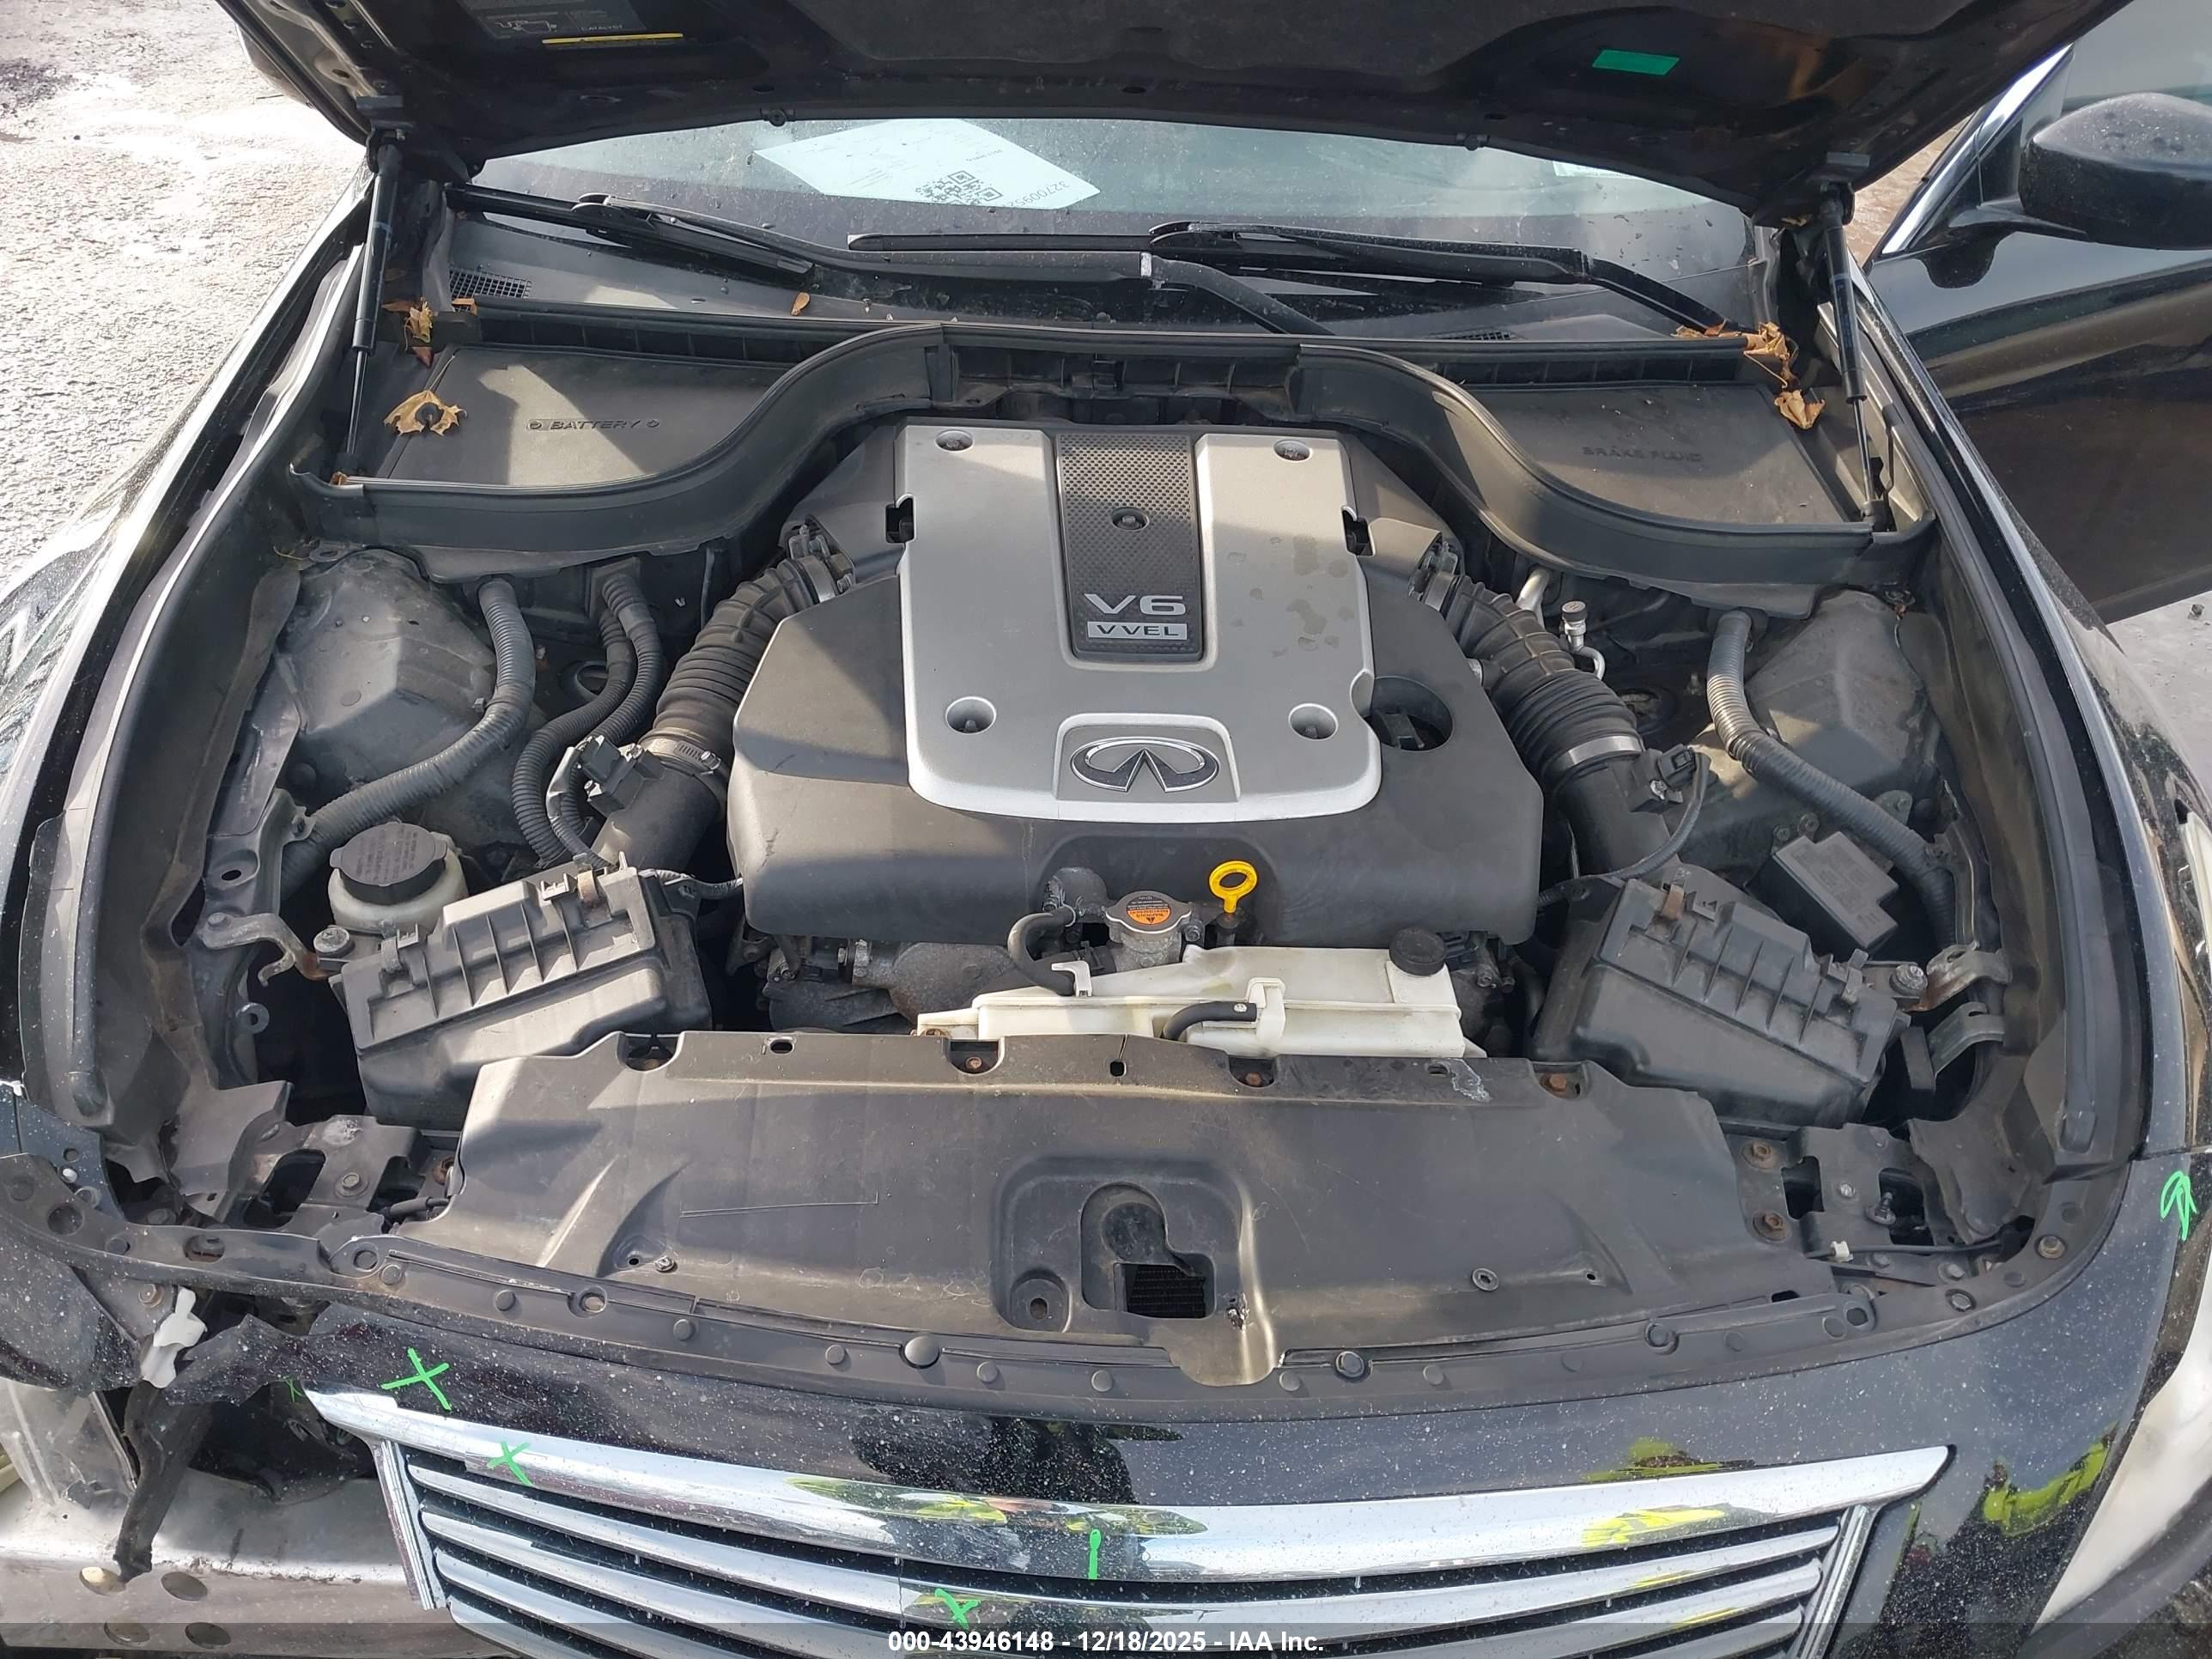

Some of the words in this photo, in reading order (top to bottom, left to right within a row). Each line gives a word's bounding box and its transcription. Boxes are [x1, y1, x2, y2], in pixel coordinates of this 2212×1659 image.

[550, 418, 641, 430] BATTERY
[1582, 446, 1644, 459] BRAKE
[1649, 450, 1705, 462] FLUID
[1084, 593, 1187, 616] V6
[1097, 624, 1180, 636] VVEL
